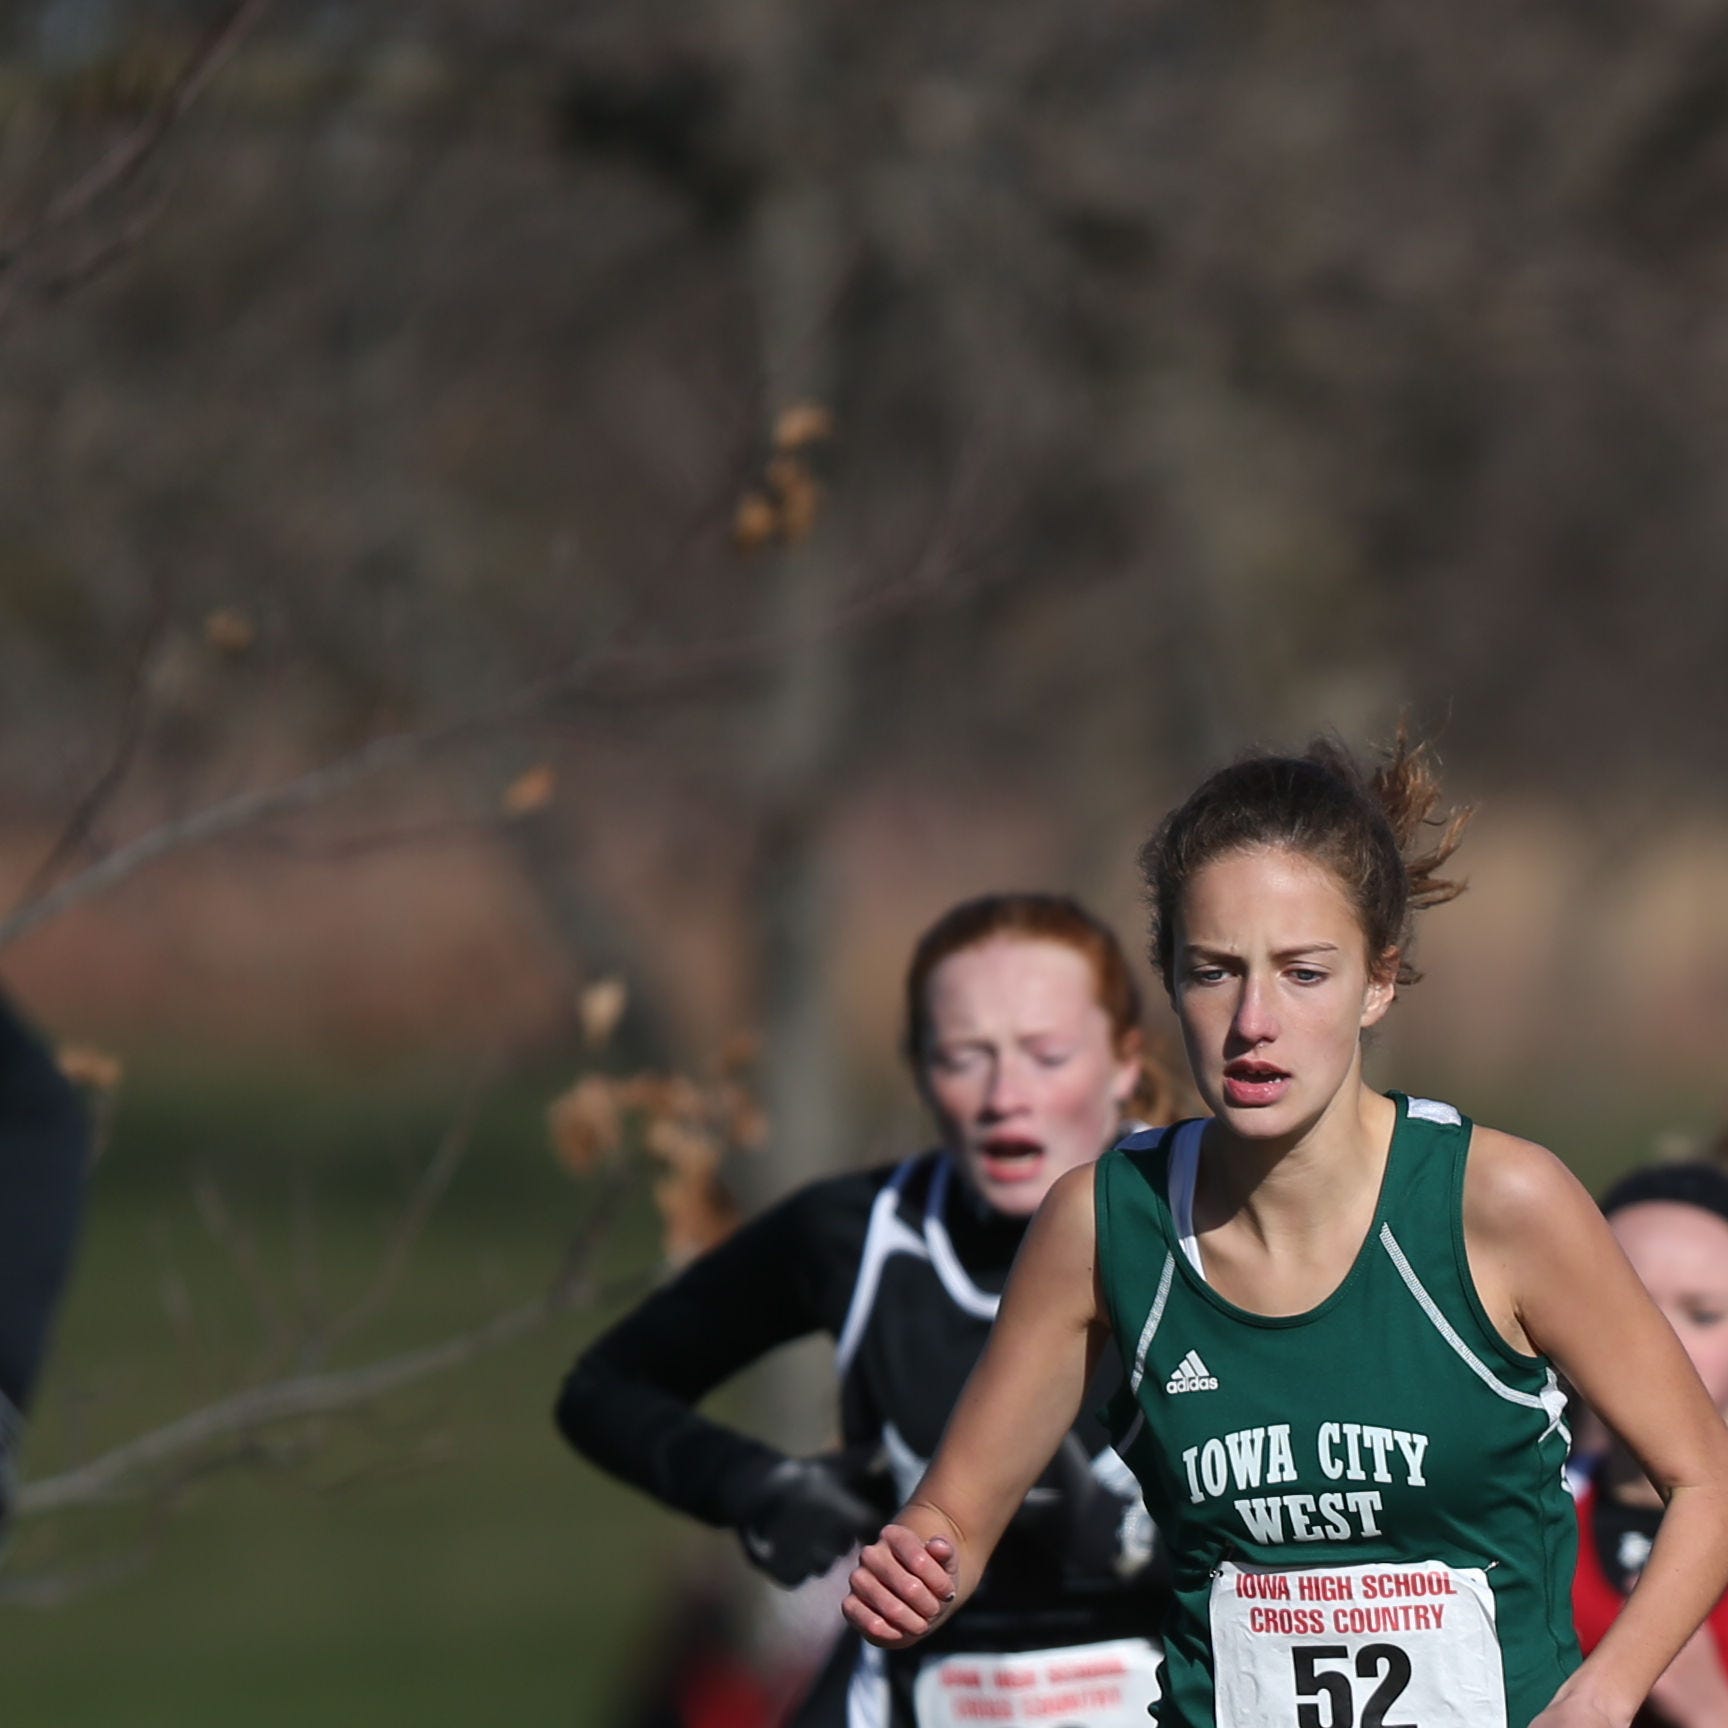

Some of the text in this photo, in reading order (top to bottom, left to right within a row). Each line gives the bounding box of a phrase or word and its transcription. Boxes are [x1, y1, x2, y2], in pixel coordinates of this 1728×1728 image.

[1166, 1373, 1219, 1394] adidas
[1183, 1421, 1429, 1503] IOWA CITY
[1235, 1491, 1383, 1545] WEST
[1236, 1571, 1458, 1600] IOWA HIGH SCHOOL
[1250, 1603, 1445, 1635] CROSS COUNTRY
